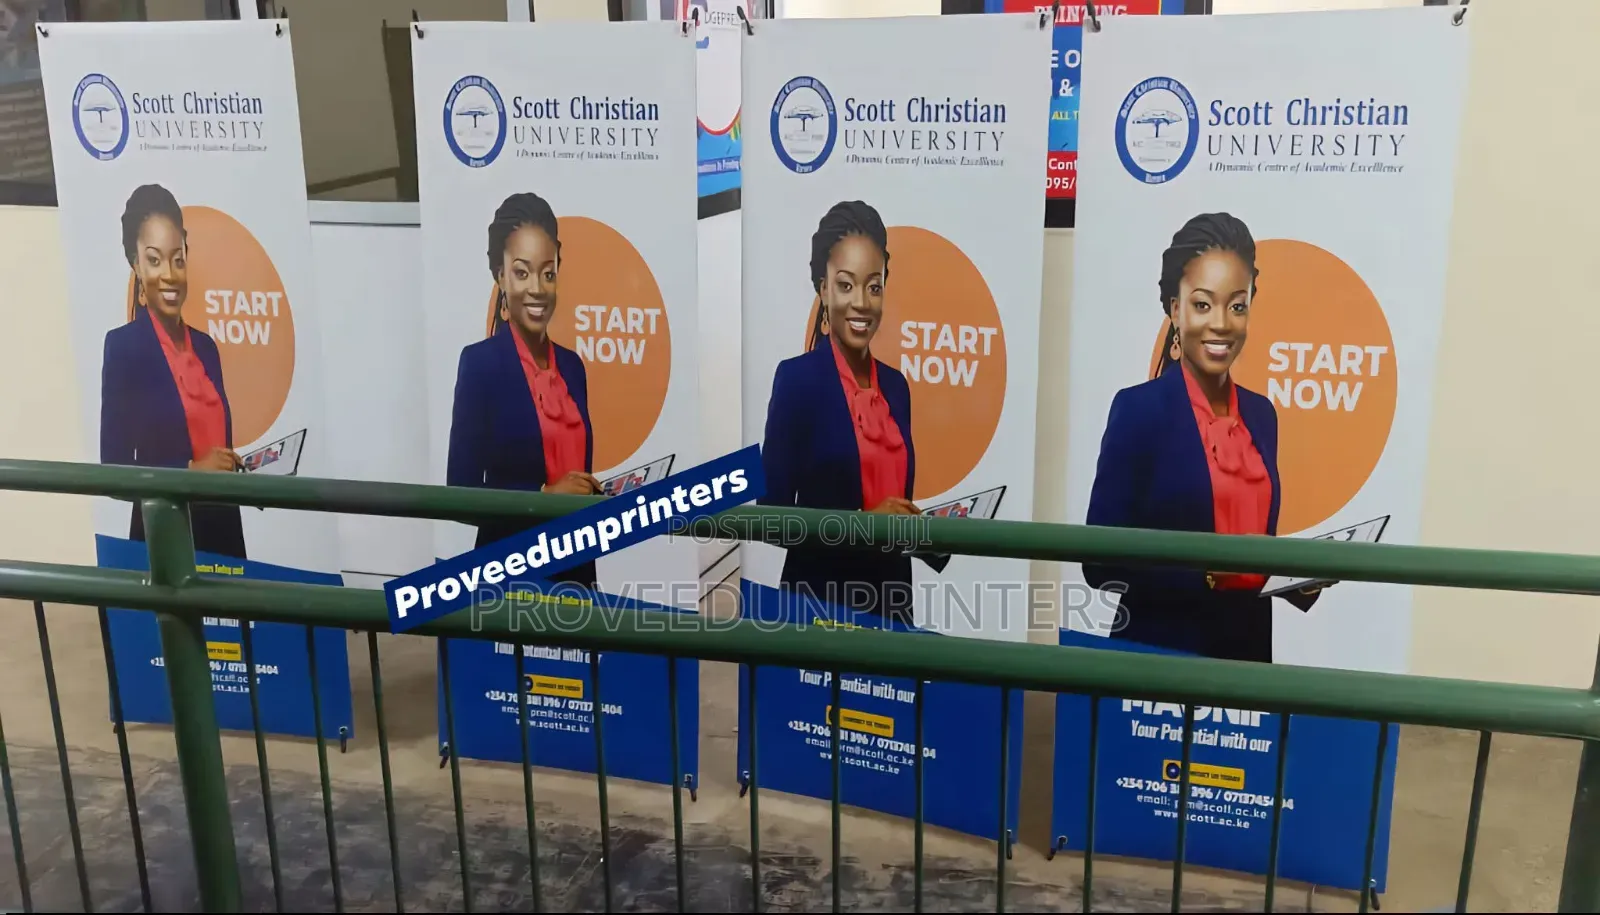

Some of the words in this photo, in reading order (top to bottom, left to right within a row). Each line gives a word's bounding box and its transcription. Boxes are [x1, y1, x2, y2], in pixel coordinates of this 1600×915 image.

[1059, 79, 1073, 97] &
[132, 92, 175, 115] Scott
[183, 91, 263, 115] Christian
[512, 96, 560, 119] Scott
[570, 96, 660, 121] Christian
[844, 97, 896, 122] Scott
[907, 96, 1006, 123] Christian
[1208, 99, 1273, 126] Scott
[1286, 97, 1409, 126] Christian
[135, 119, 265, 139] UNIVERSITY
[514, 125, 659, 146] UNIVERSITY
[844, 129, 1004, 151] UNIVERSITY
[1208, 133, 1406, 156] UNIVERSITY
[204, 290, 282, 317] START
[208, 319, 270, 345] NOW
[575, 304, 661, 334] START
[575, 336, 646, 365] NOW
[900, 320, 998, 356] START
[900, 353, 979, 387] NOW
[1267, 341, 1388, 377] START
[1267, 377, 1363, 411] NOW
[799, 668, 821, 687] Your
[872, 682, 895, 700] with
[897, 690, 915, 703] our
[1131, 719, 1159, 740] Your
[1220, 731, 1246, 750] with
[1249, 739, 1272, 753] our
[1145, 780, 1168, 793] 706
[1191, 786, 1214, 800] 396
